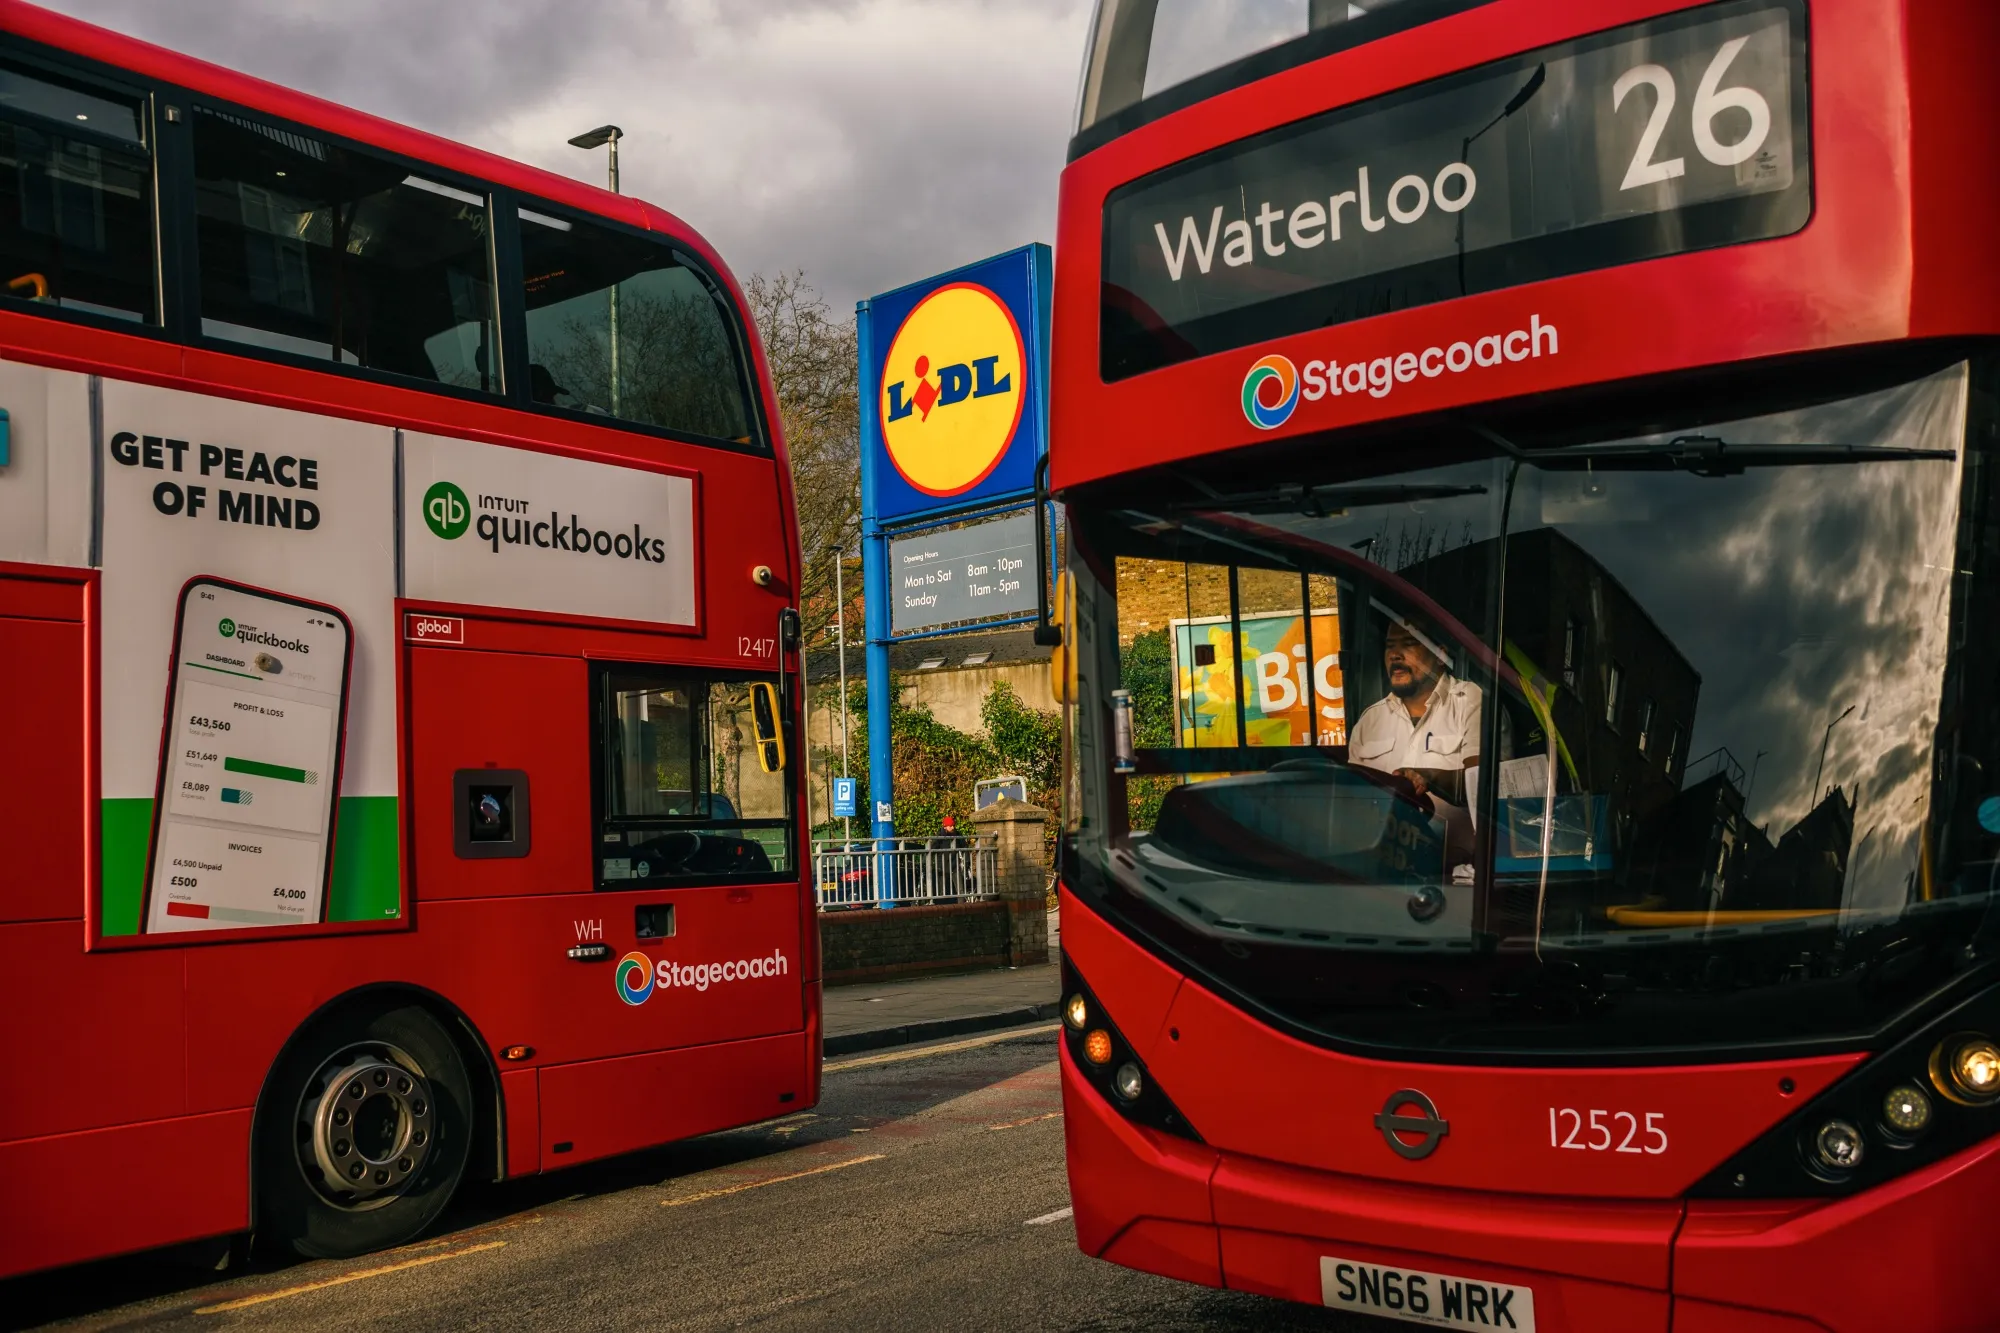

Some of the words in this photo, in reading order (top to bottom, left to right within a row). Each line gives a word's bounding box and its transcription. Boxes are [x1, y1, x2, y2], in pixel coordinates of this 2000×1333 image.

[1613, 34, 1770, 192] 26
[1155, 162, 1476, 282] Waterloo
[1302, 314, 1558, 402] Stagecoach
[110, 431, 190, 472] GET
[200, 443, 319, 490] PEACE
[152, 481, 206, 518] OF
[218, 490, 320, 530] MIND
[478, 494, 530, 514] INTUIT
[476, 512, 666, 564] quickbooks
[904, 553, 924, 564] Opening
[924, 550, 939, 559] Hours
[904, 576, 924, 588] Mon
[926, 573, 935, 584] to
[938, 569, 952, 582] Sat
[968, 564, 988, 577] 8am
[200, 592, 215, 601] 9:41
[905, 592, 938, 608] Sunday
[969, 584, 991, 597] 11am
[999, 579, 1020, 595] 5pm
[416, 619, 452, 637] global
[236, 630, 310, 654] quickbooks
[738, 636, 775, 658] 12417
[206, 653, 246, 667] DASHBOARD
[234, 702, 258, 713] PROFIT
[266, 708, 284, 718] LOSS
[190, 716, 231, 732] £43,560
[186, 750, 218, 762] £51,649
[182, 781, 210, 792] £8,089
[841, 785, 848, 798] P
[228, 843, 263, 854] INVOICES
[173, 859, 197, 868] £4,500
[198, 862, 222, 872] Unpaid
[171, 876, 198, 888] £500
[168, 893, 191, 901] Overdue
[273, 887, 306, 900] £4,000
[574, 919, 603, 941] WH
[656, 949, 788, 992] Stagecoach
[1549, 1107, 1668, 1155] 12525
[1335, 1263, 1430, 1315] SN66
[1440, 1279, 1517, 1329] WRK
